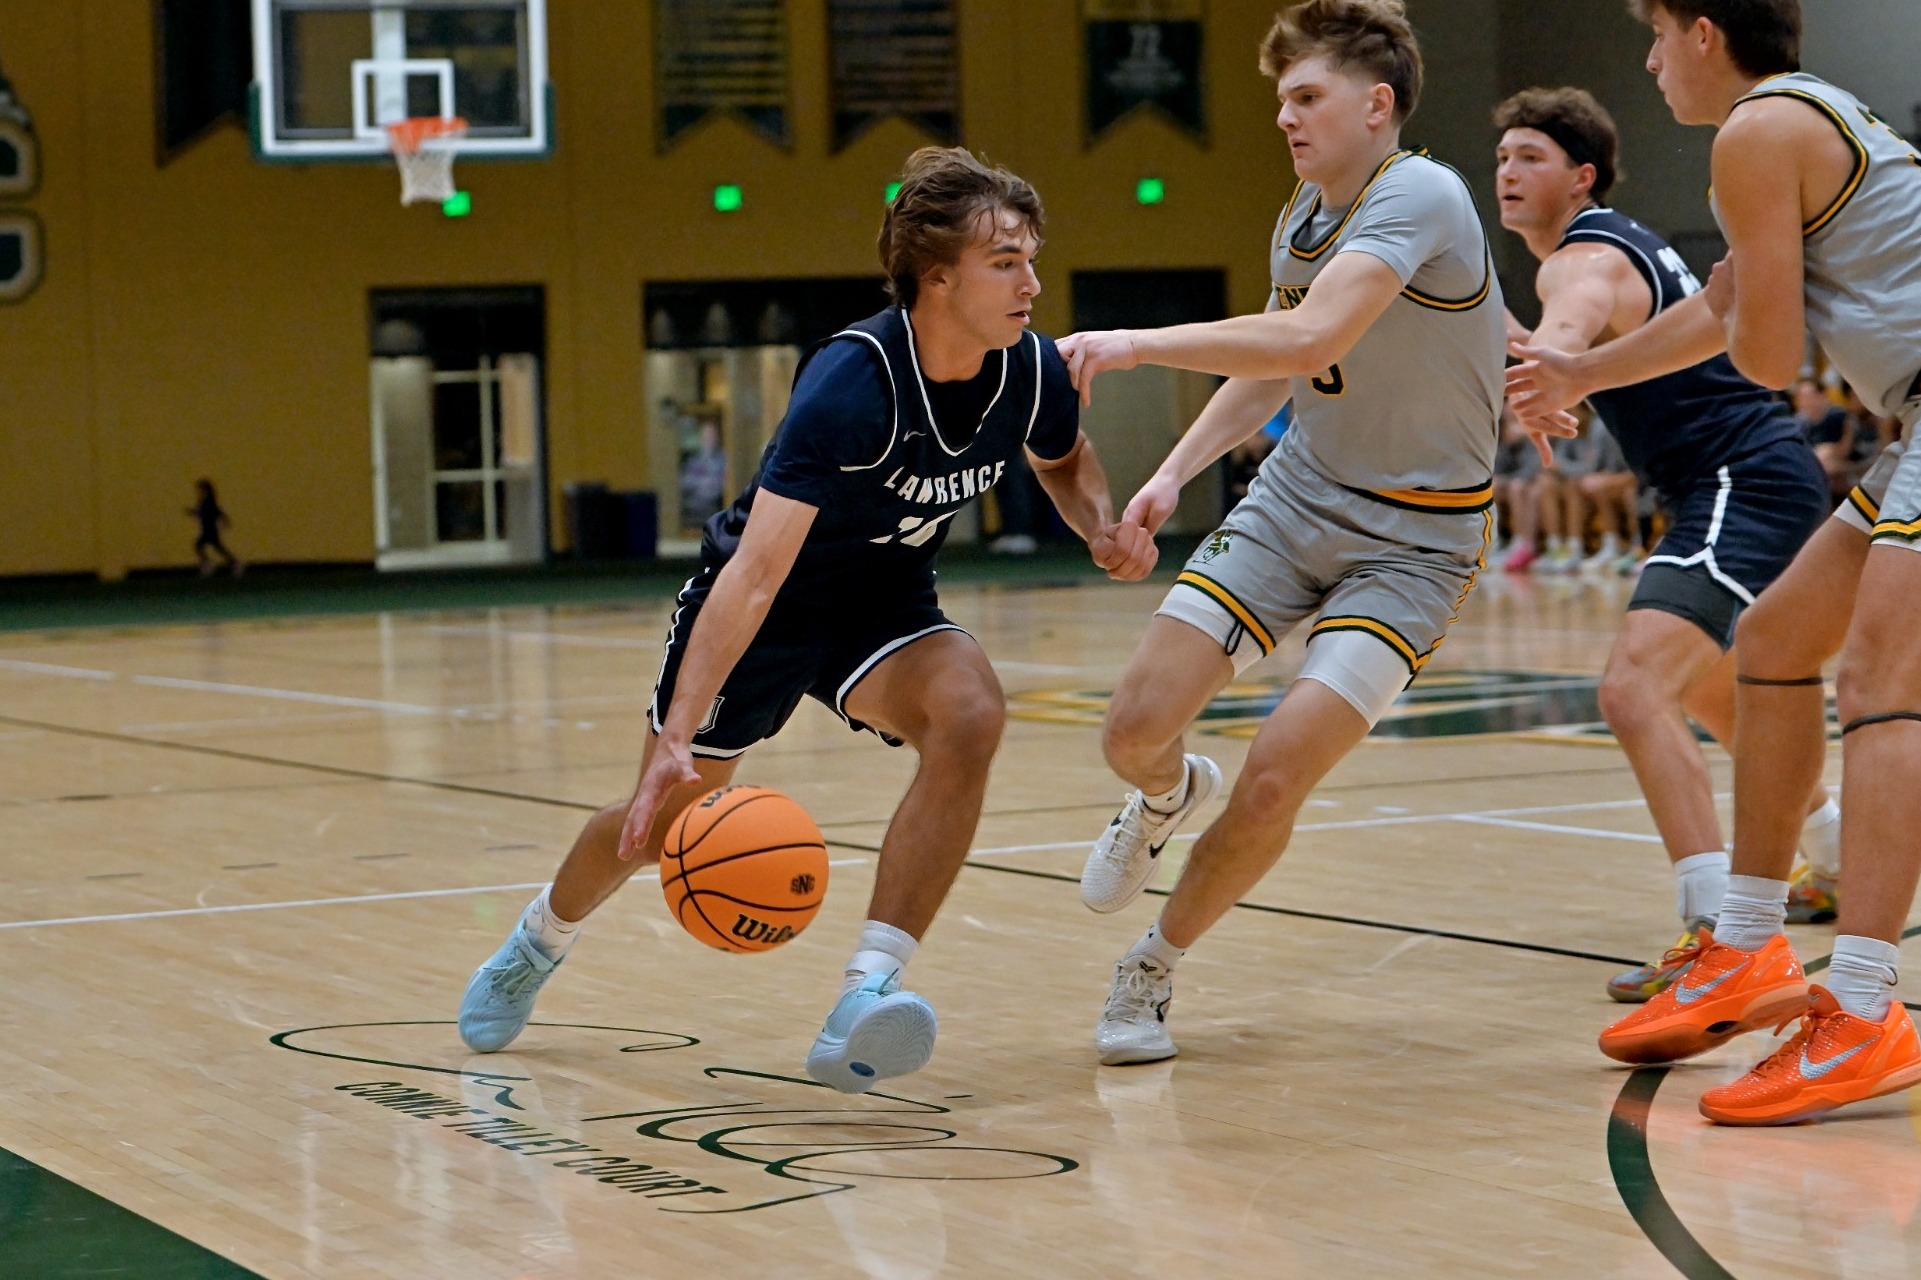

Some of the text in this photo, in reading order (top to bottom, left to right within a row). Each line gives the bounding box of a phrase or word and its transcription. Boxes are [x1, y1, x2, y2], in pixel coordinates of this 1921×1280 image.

[883, 460, 1006, 505] LAWRENCE
[334, 1081, 728, 1199] CONNIE TILLEY COURT
